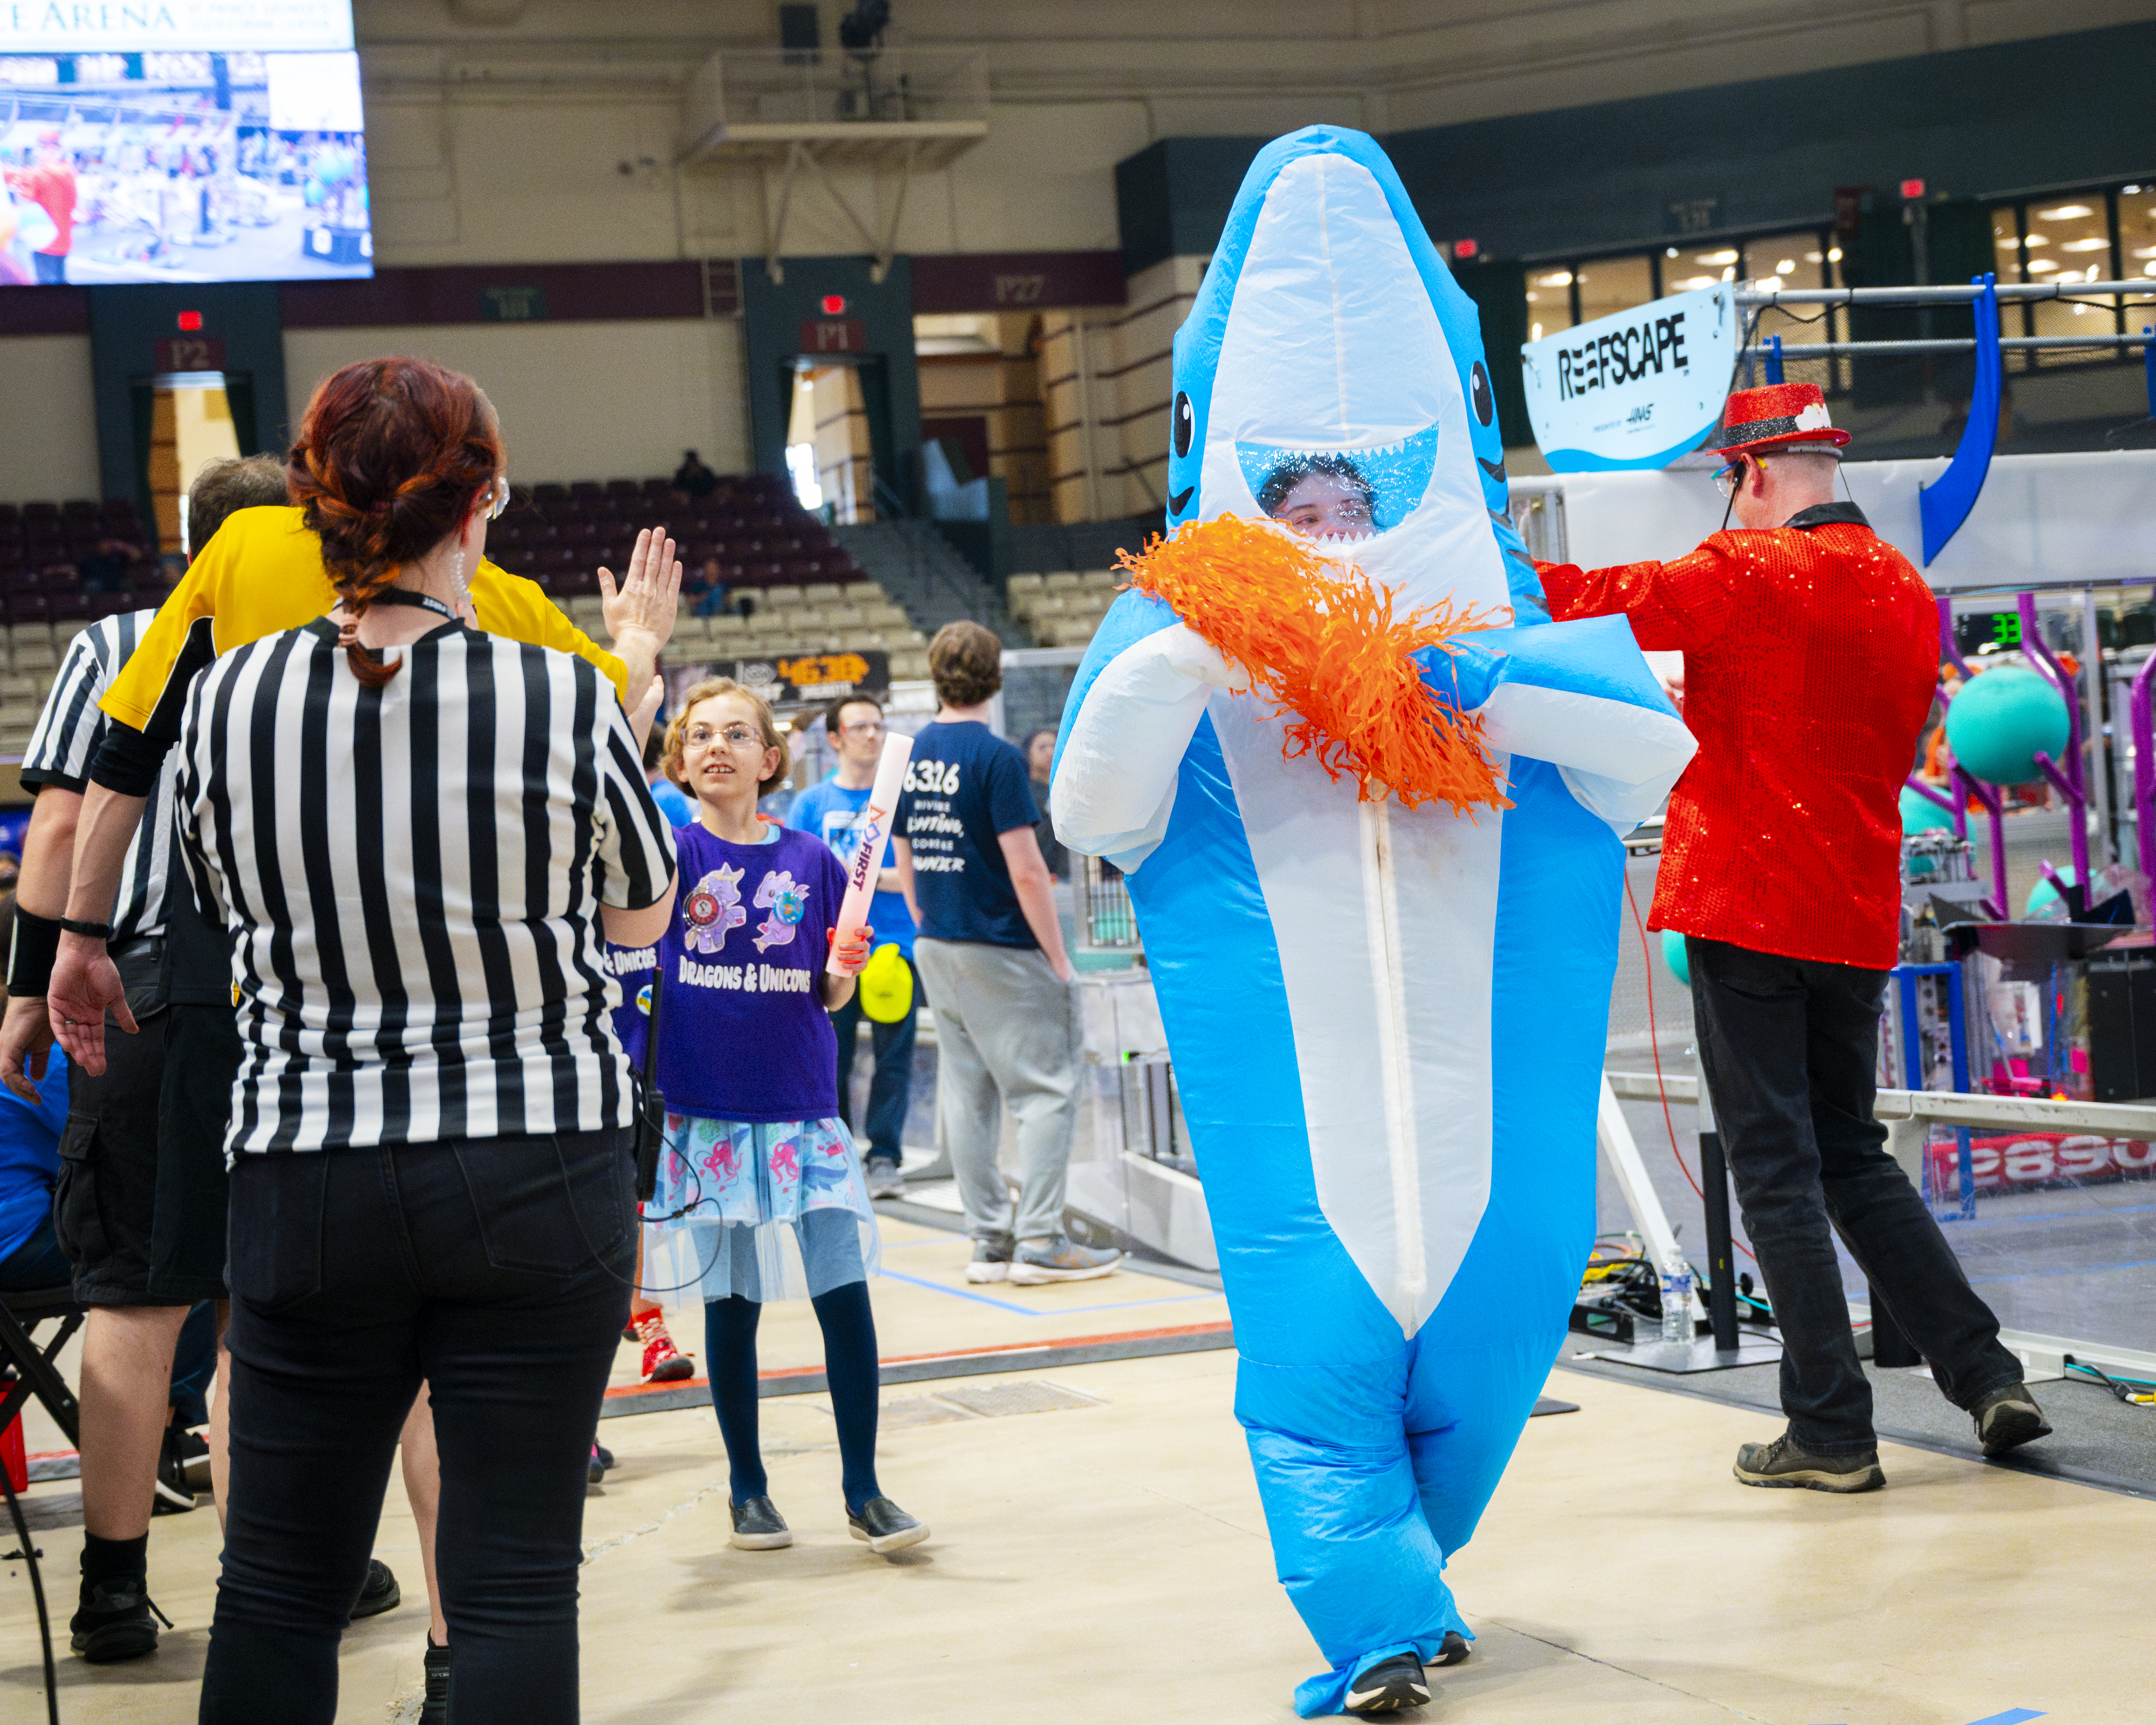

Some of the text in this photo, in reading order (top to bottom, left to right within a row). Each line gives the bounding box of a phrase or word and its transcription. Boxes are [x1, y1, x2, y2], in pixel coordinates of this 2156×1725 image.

[41, 1, 177, 31] ARENA
[903, 759, 960, 795] 6316
[853, 841, 873, 891] FIRST
[743, 963, 758, 993] &
